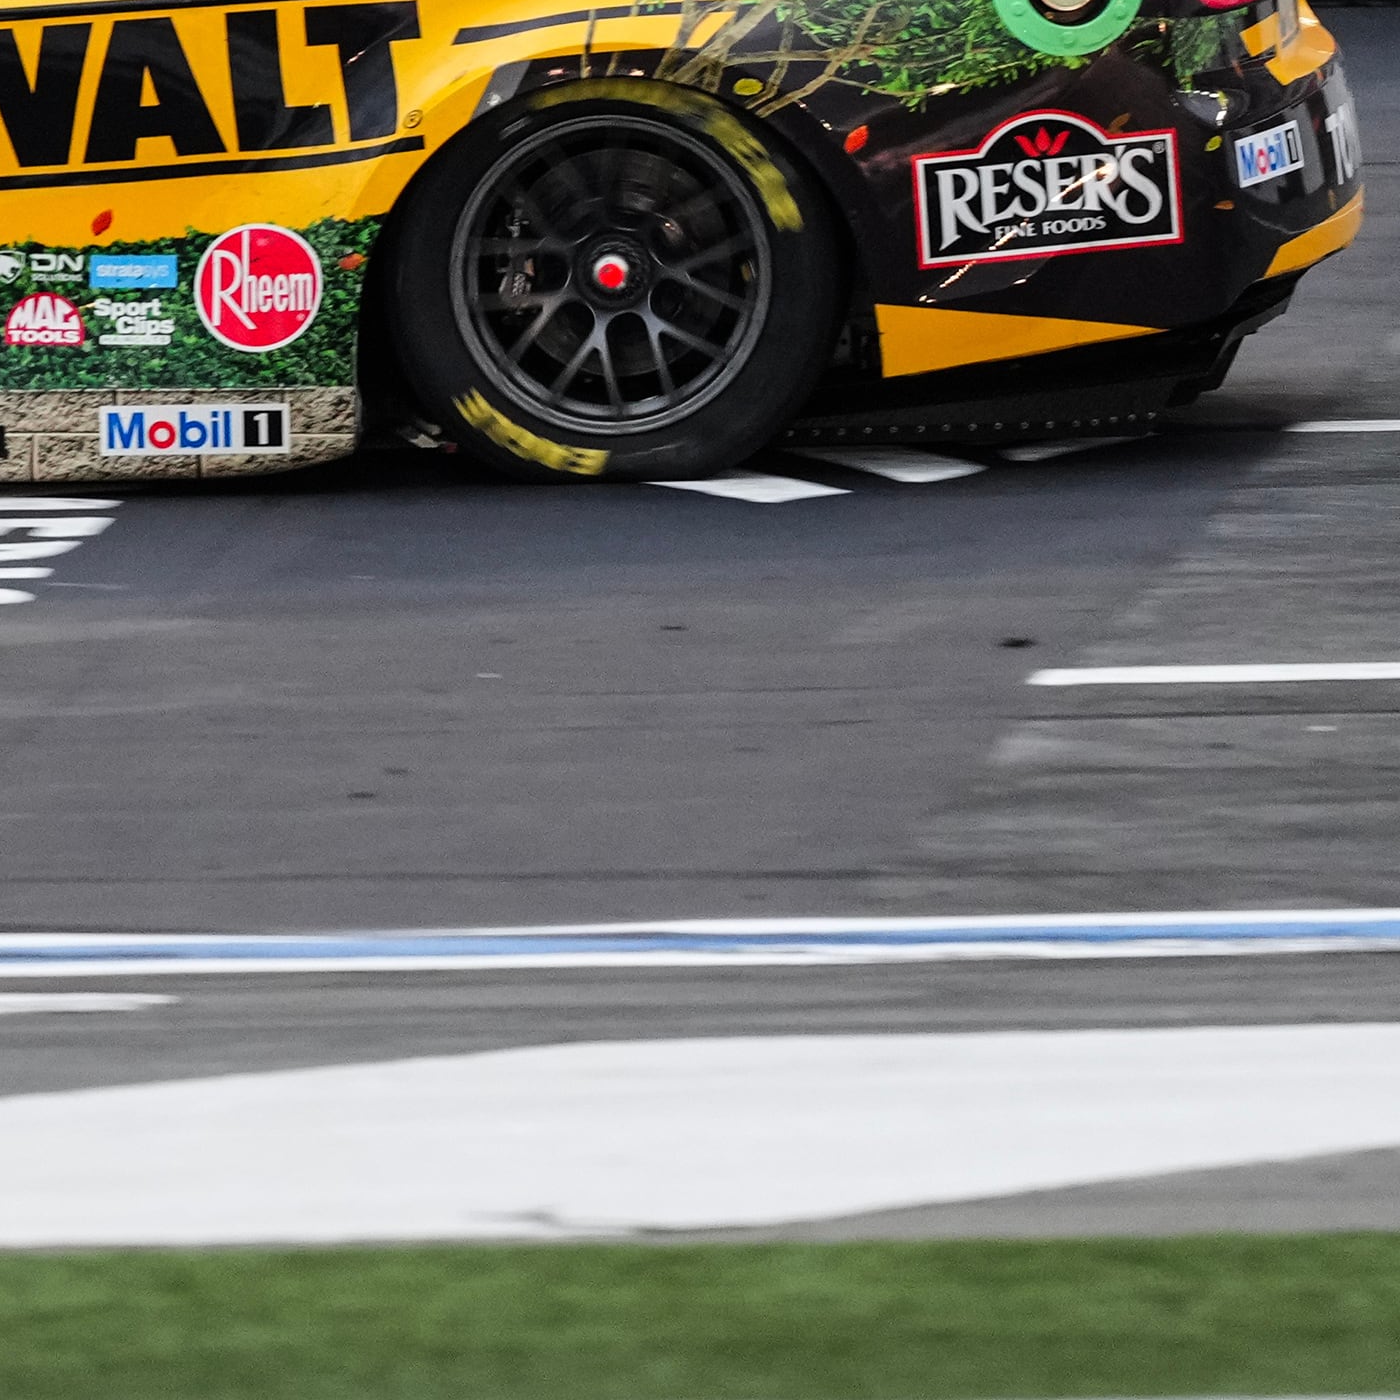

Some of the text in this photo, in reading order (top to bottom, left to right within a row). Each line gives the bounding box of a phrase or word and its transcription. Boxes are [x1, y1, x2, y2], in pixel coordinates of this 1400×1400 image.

[1240, 133, 1286, 181] Mobil
[934, 145, 1163, 251] RESER'S
[995, 216, 1107, 241] FINE FOODS
[28, 254, 84, 272] DN
[211, 230, 313, 330] Rheem
[94, 297, 162, 320] Sport
[8, 329, 80, 343] TOOLS
[115, 317, 175, 335] Clips
[107, 410, 232, 449] Mobil
